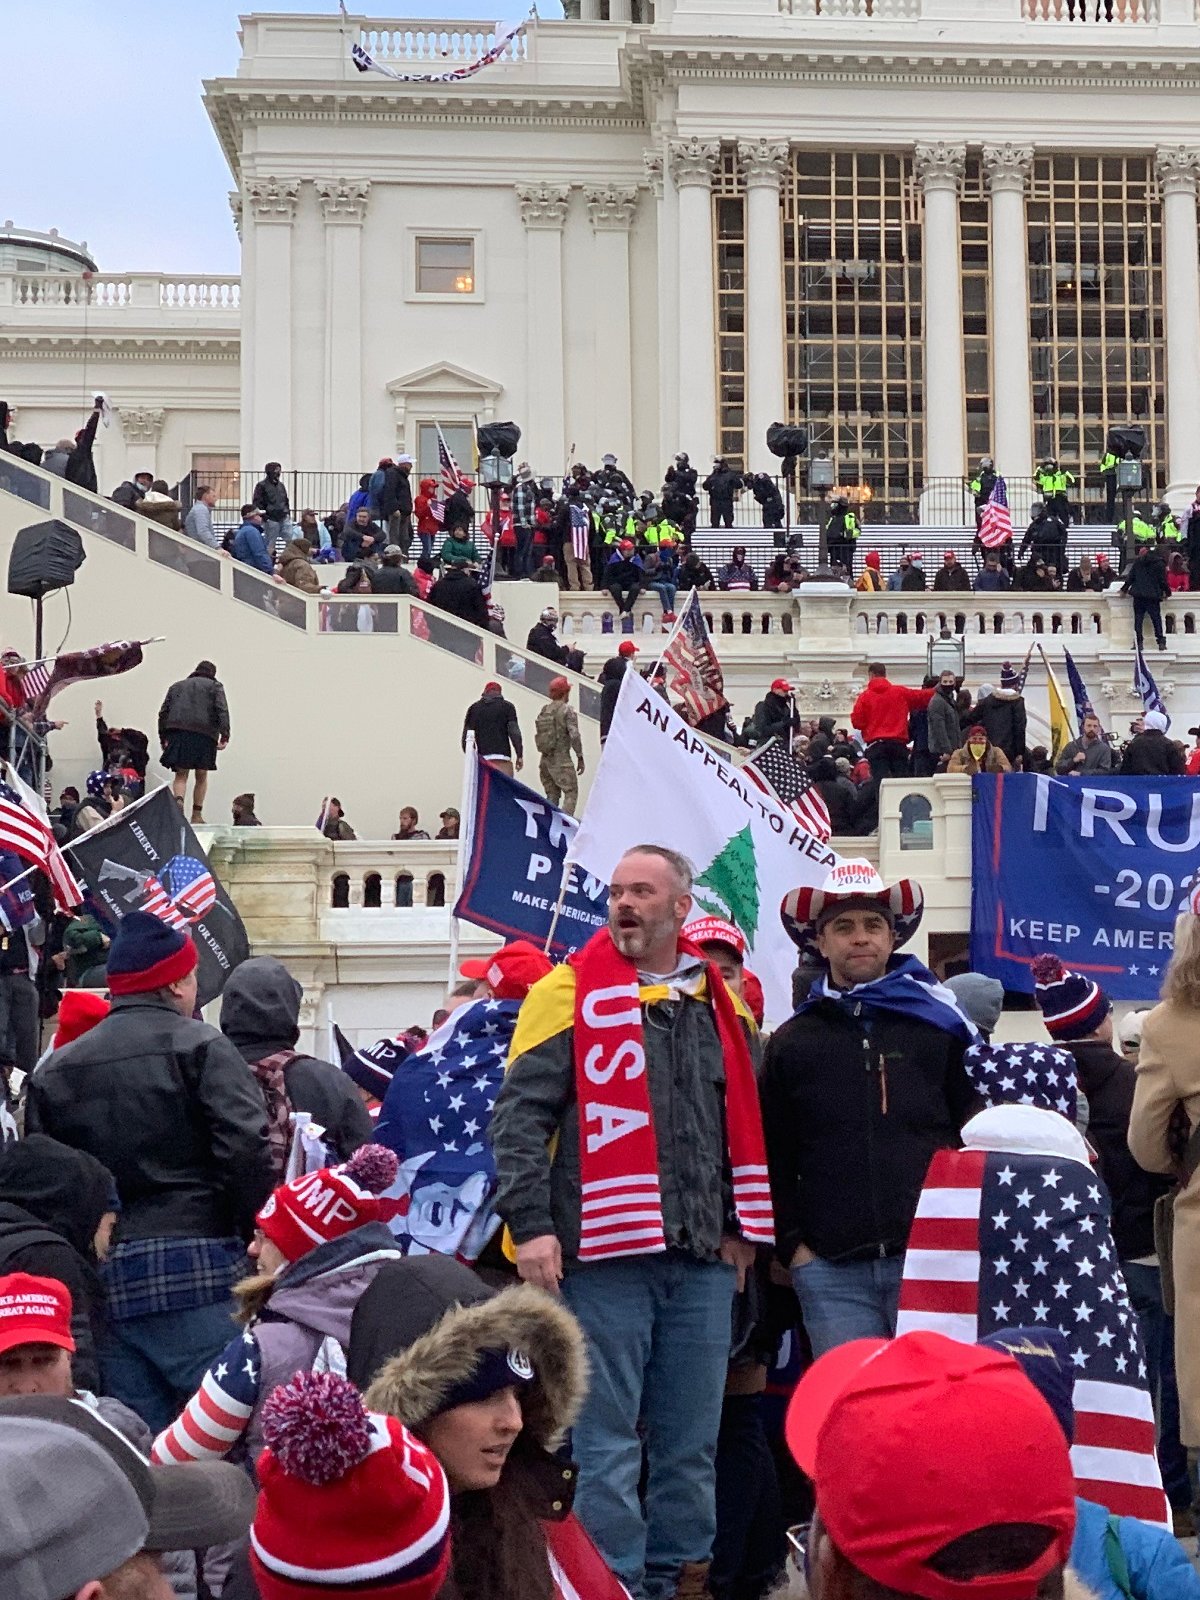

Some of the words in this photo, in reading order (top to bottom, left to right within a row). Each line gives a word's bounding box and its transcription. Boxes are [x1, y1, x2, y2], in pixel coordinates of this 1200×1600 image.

[636, 697, 669, 732] AN
[673, 728, 754, 809] APPEAL
[757, 801, 784, 833] TO
[129, 820, 160, 861] LIBERTY
[831, 864, 877, 881] TRUMP
[837, 875, 871, 887] 2020
[512, 890, 548, 910] MAKE
[684, 921, 705, 936] MAKE
[706, 920, 742, 937] AMERICA
[1009, 918, 1081, 943] KEEP
[197, 923, 211, 939] OR
[207, 936, 231, 970] DEATH
[715, 932, 738, 946] AGAIN
[581, 982, 650, 1154] USA
[15, 1294, 60, 1306] AMERICA
[25, 1306, 55, 1317] AGAIN
